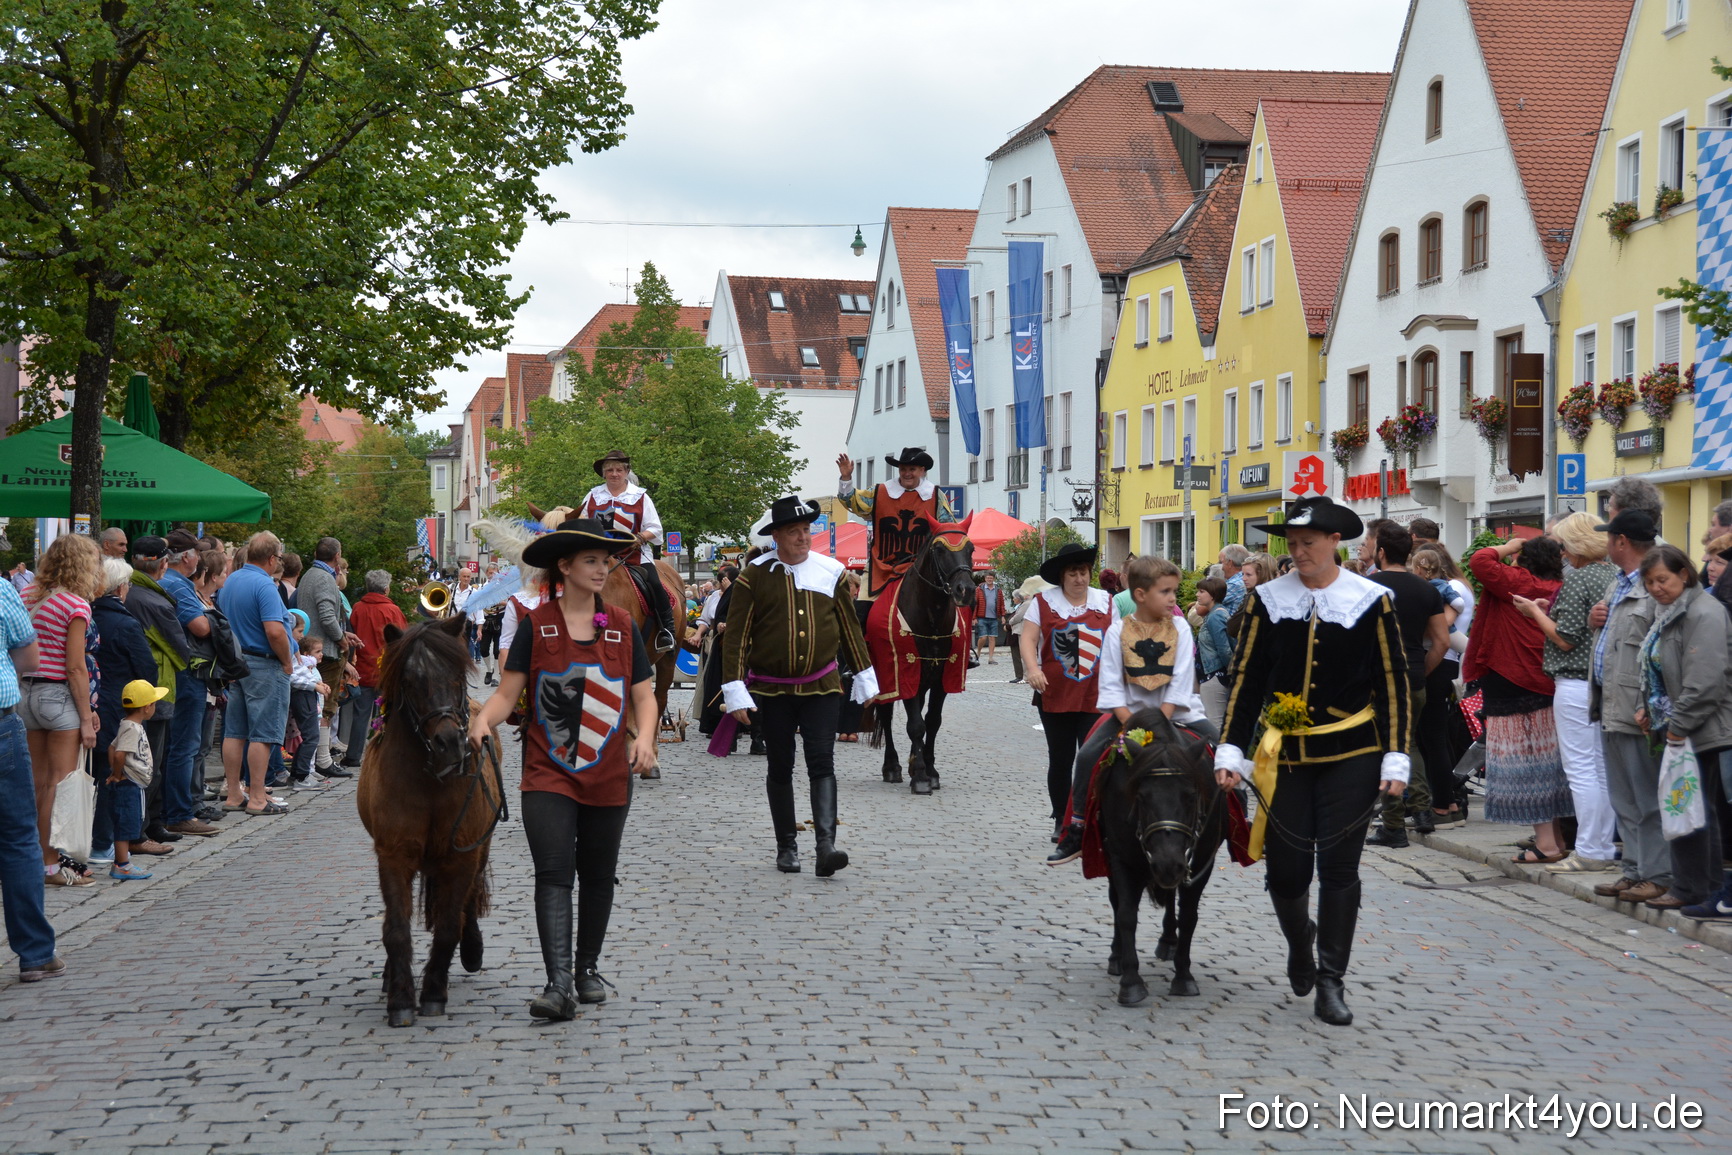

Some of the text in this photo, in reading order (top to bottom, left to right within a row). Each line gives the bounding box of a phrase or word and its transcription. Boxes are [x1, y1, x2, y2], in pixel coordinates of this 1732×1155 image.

[1015, 322, 1032, 370] K&L
[1148, 365, 1209, 397] HOTEL Lehmeier
[1616, 438, 1635, 451] WOLLE
[1639, 434, 1653, 448] MEH
[1184, 440, 1189, 465] P
[25, 466, 138, 478] Neumkter
[1222, 463, 1227, 489] P
[1238, 467, 1263, 485] TAIFUN
[1563, 458, 1580, 490] P
[1, 474, 157, 489] Lammbräu
[1144, 492, 1180, 510] Restaurant
[469, 562, 477, 571] T
